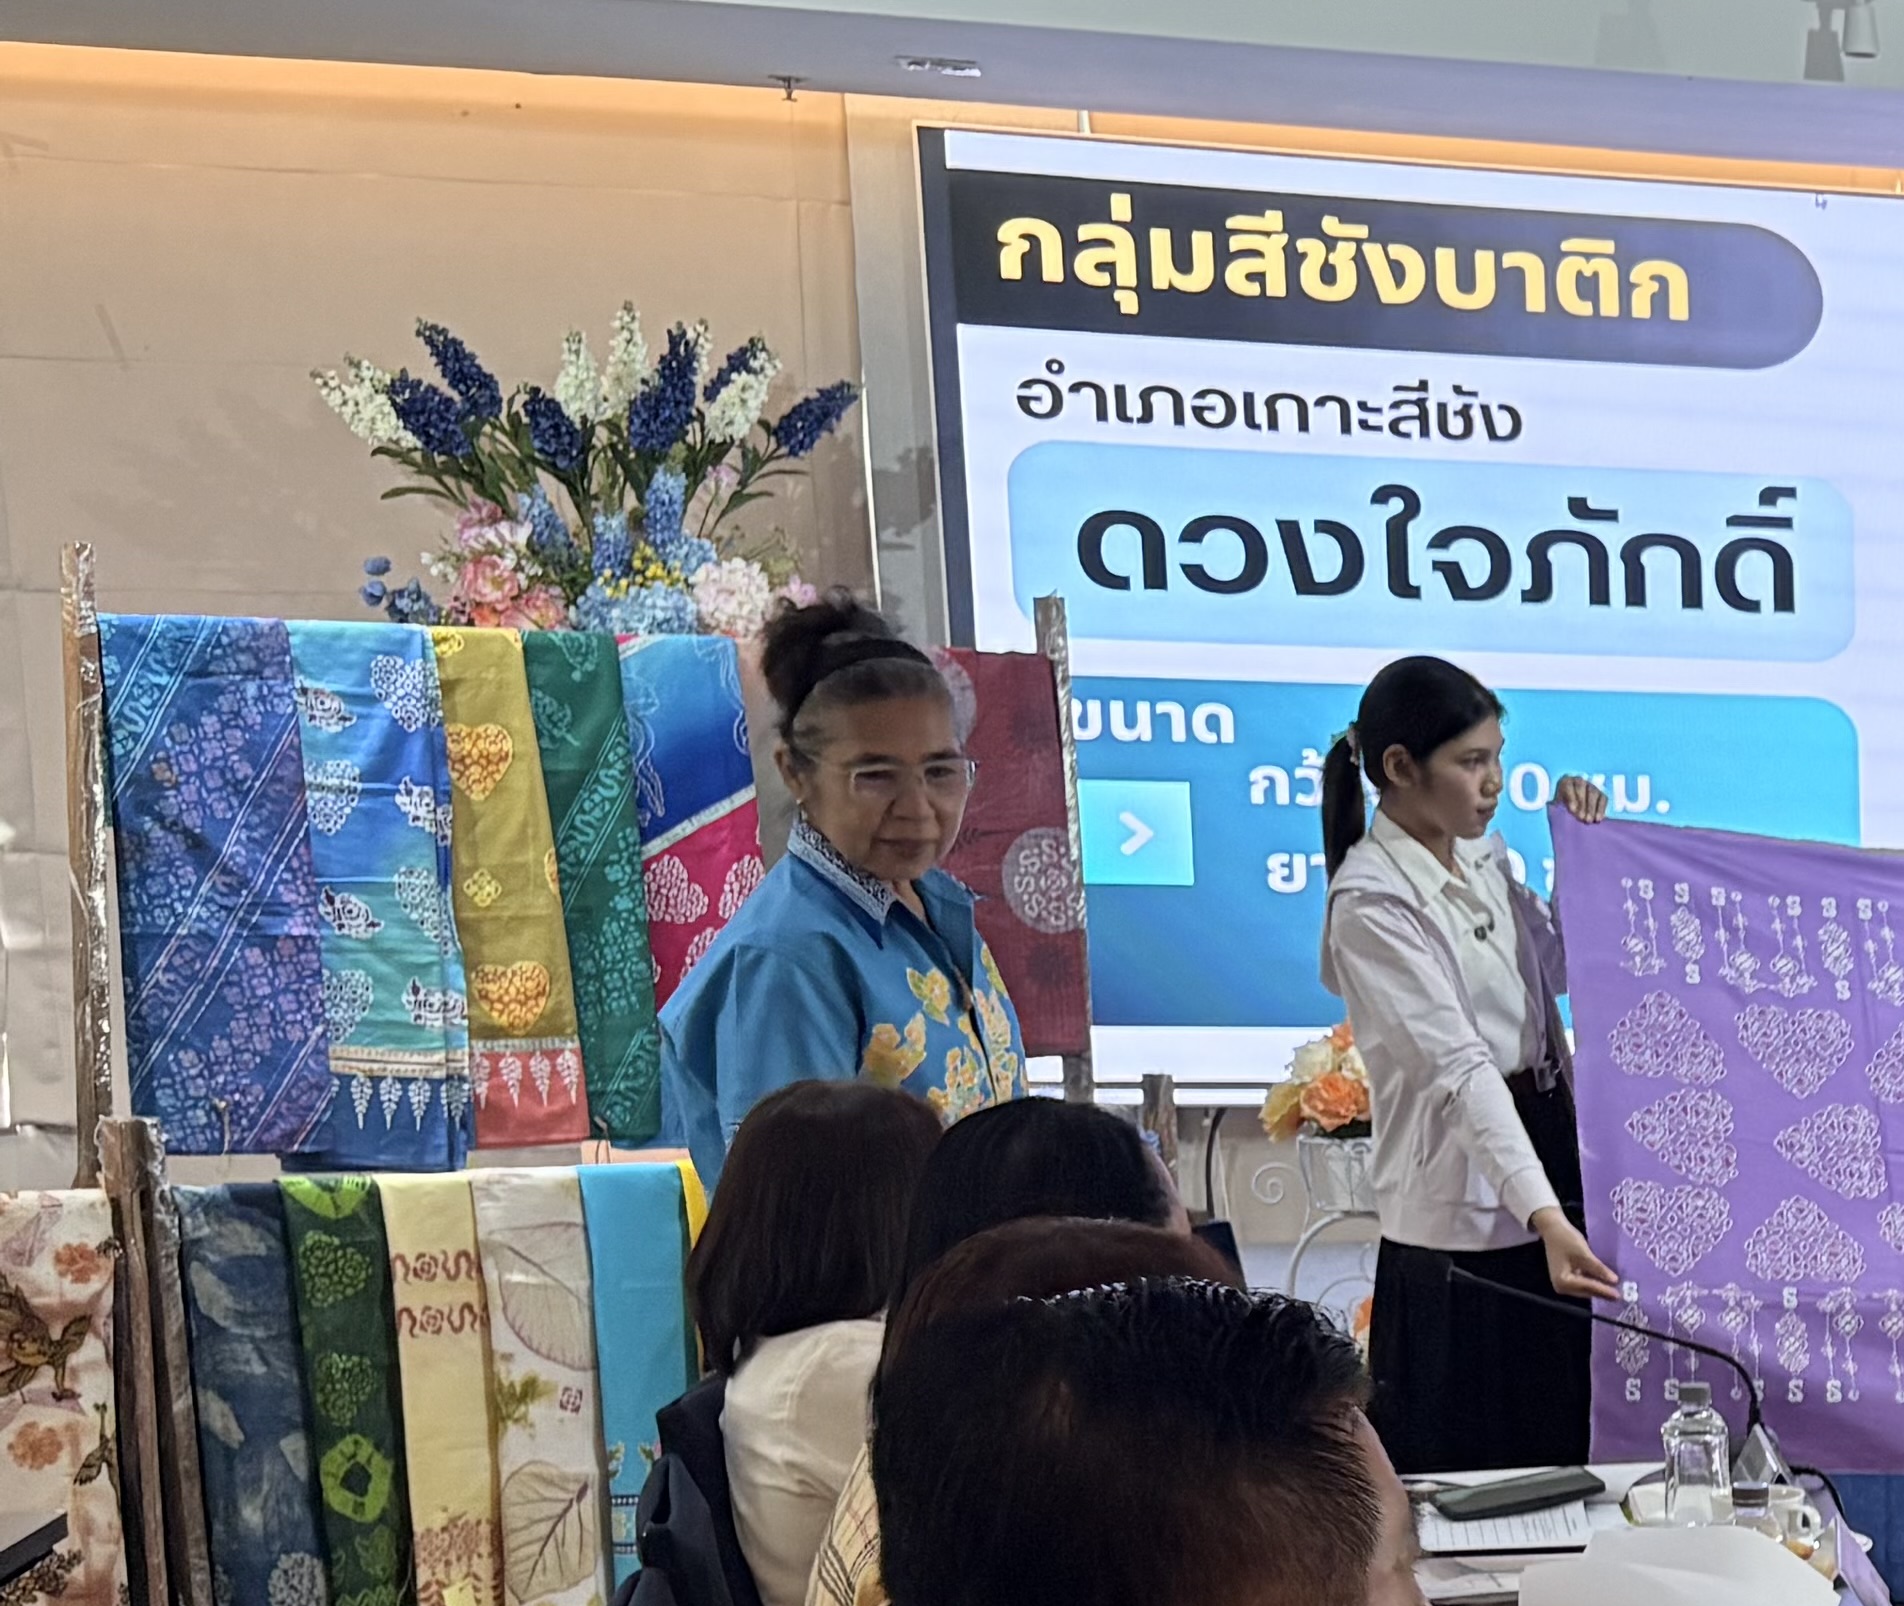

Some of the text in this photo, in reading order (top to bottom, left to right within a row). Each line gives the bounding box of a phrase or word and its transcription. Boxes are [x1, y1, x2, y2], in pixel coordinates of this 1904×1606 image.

[997, 193, 1691, 321] กลุ่มสีชังบาติก
[1016, 359, 1524, 442] อำเภอเกาะสีชัง
[1076, 484, 1798, 615] ดวงใจภักดิ์
[1072, 698, 1235, 744] ขนาด
